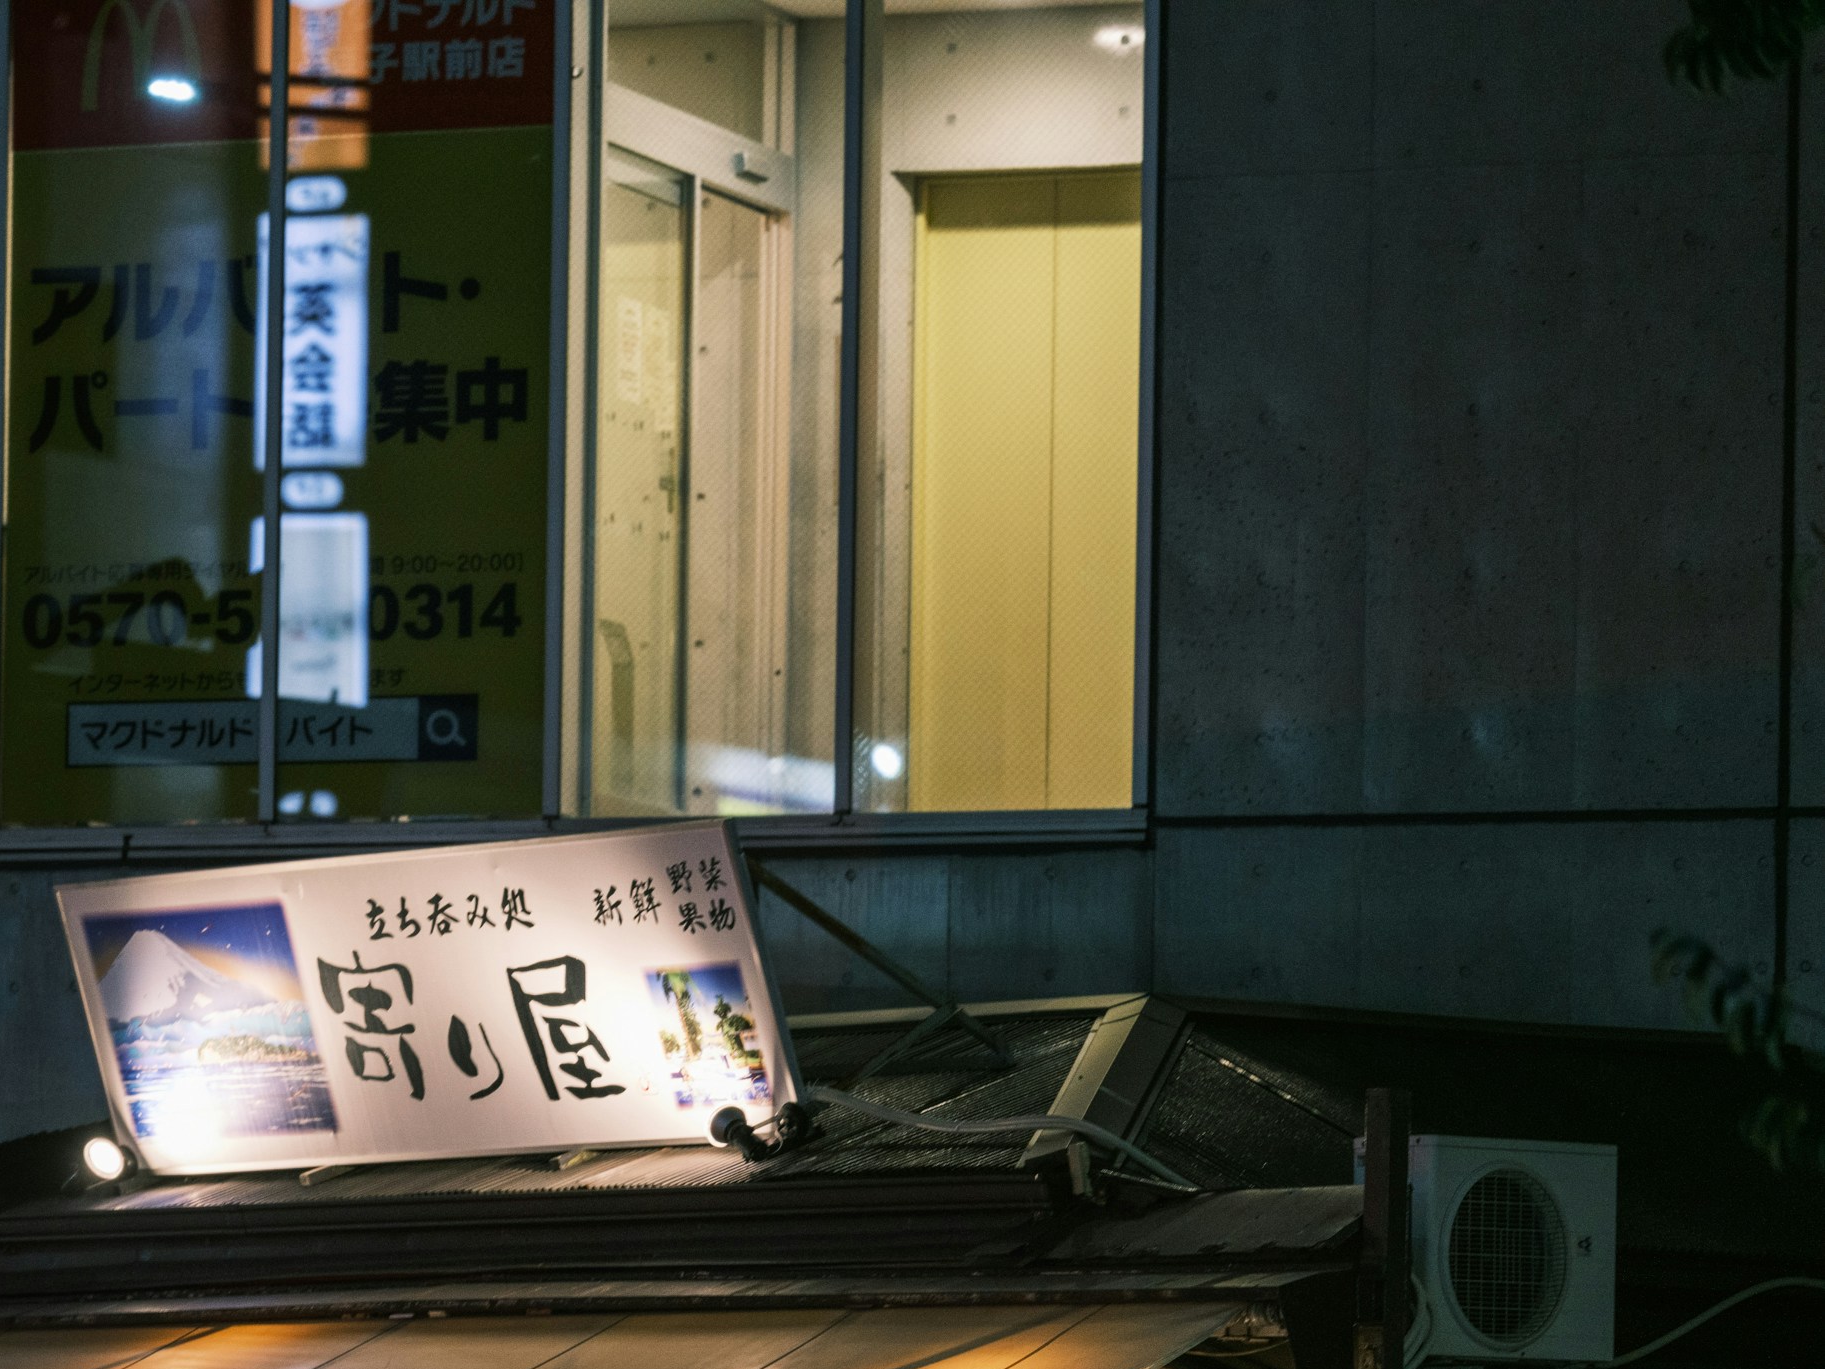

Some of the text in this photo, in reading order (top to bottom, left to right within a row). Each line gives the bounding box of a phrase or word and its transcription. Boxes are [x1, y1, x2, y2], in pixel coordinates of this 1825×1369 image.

[81, 716, 373, 749] マクドナルド バイト
[667, 857, 728, 896] 野菜
[365, 886, 536, 941] 立ち呑み処
[593, 877, 660, 926] 新鮮
[677, 900, 738, 934] 果物
[316, 950, 627, 1102] 寄り屋
